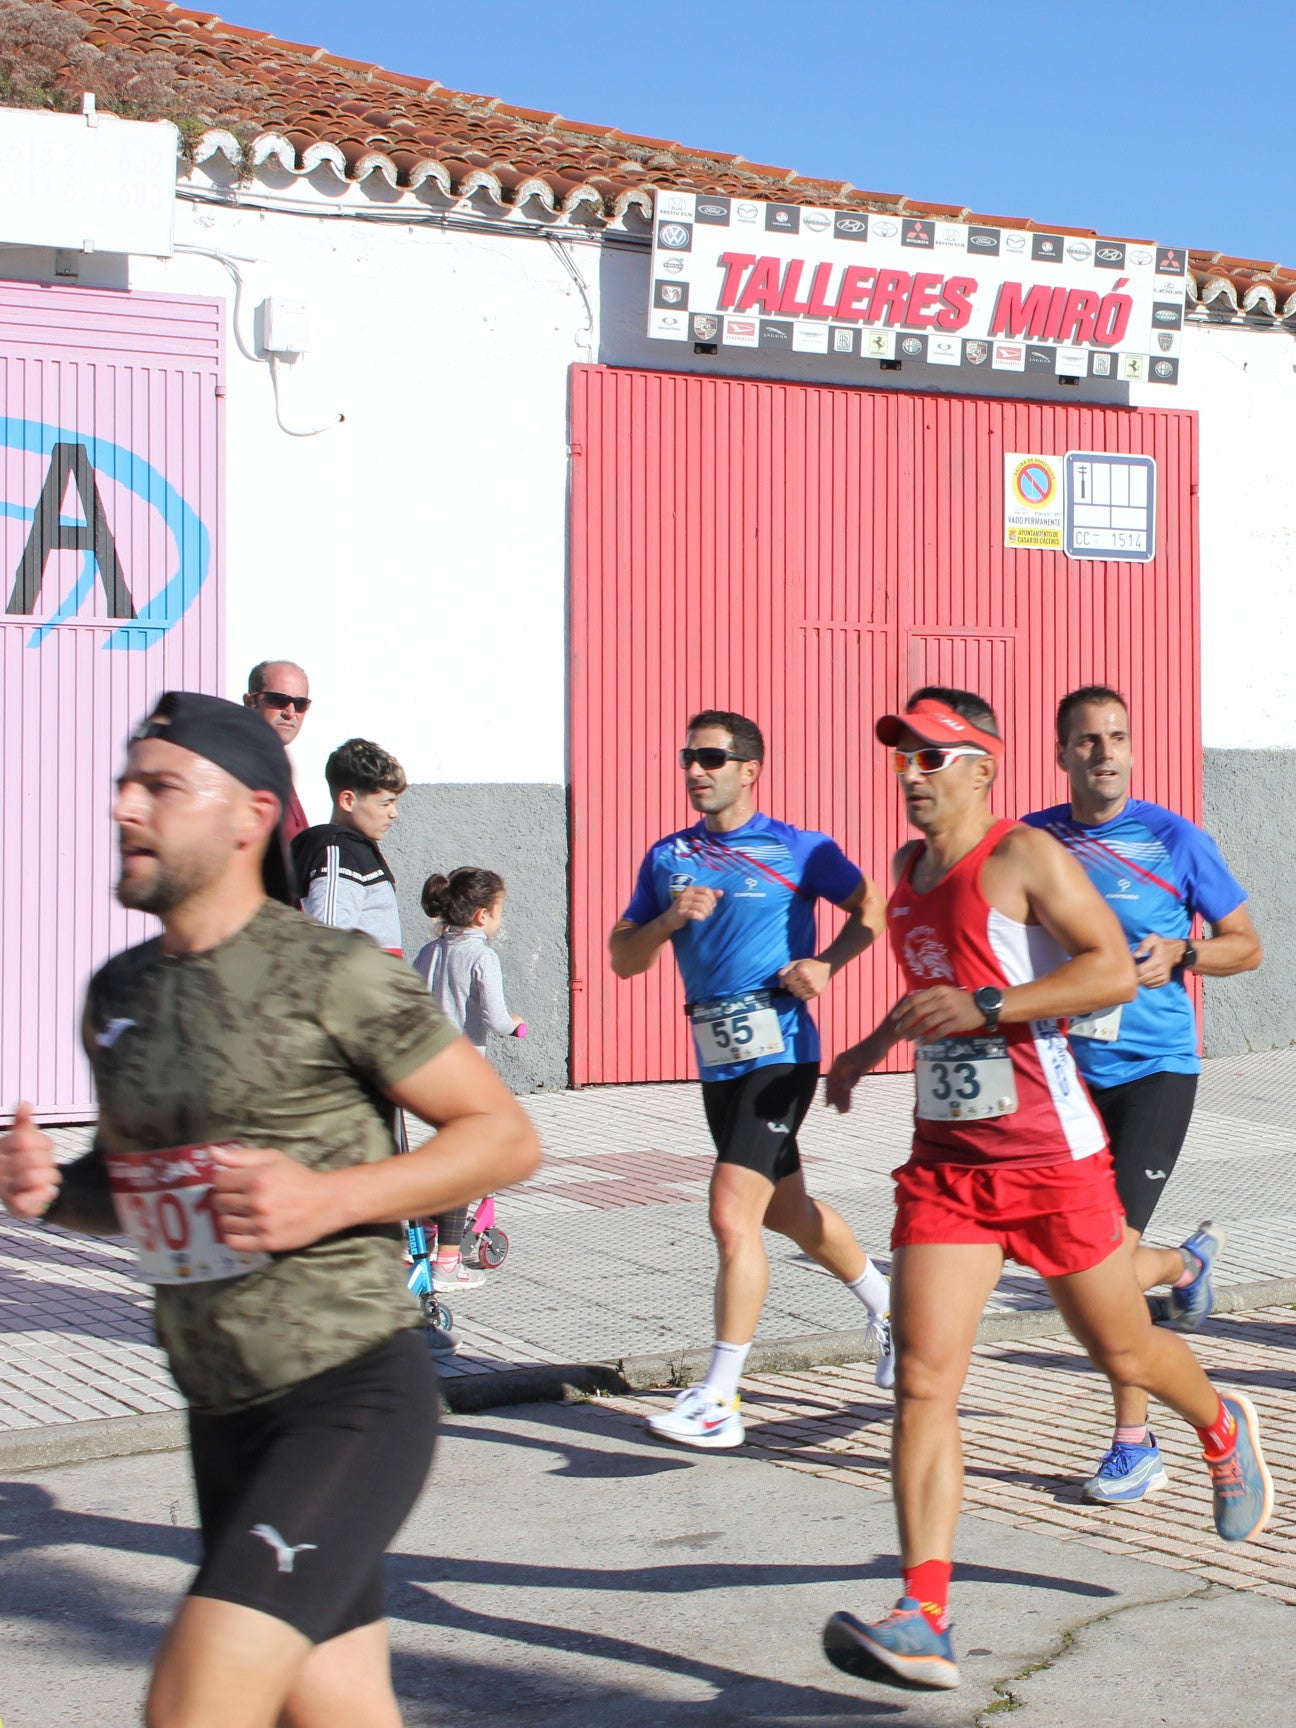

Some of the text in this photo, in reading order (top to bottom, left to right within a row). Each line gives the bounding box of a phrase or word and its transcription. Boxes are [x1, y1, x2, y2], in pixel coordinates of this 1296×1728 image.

[718, 252, 1134, 347] TALLERES MIRÓ
[6, 442, 138, 619] A
[1008, 516, 1061, 527] VADO PERMANENTE
[1112, 533, 1142, 547] 1514
[711, 1015, 753, 1049] 55
[930, 1062, 981, 1101] 33
